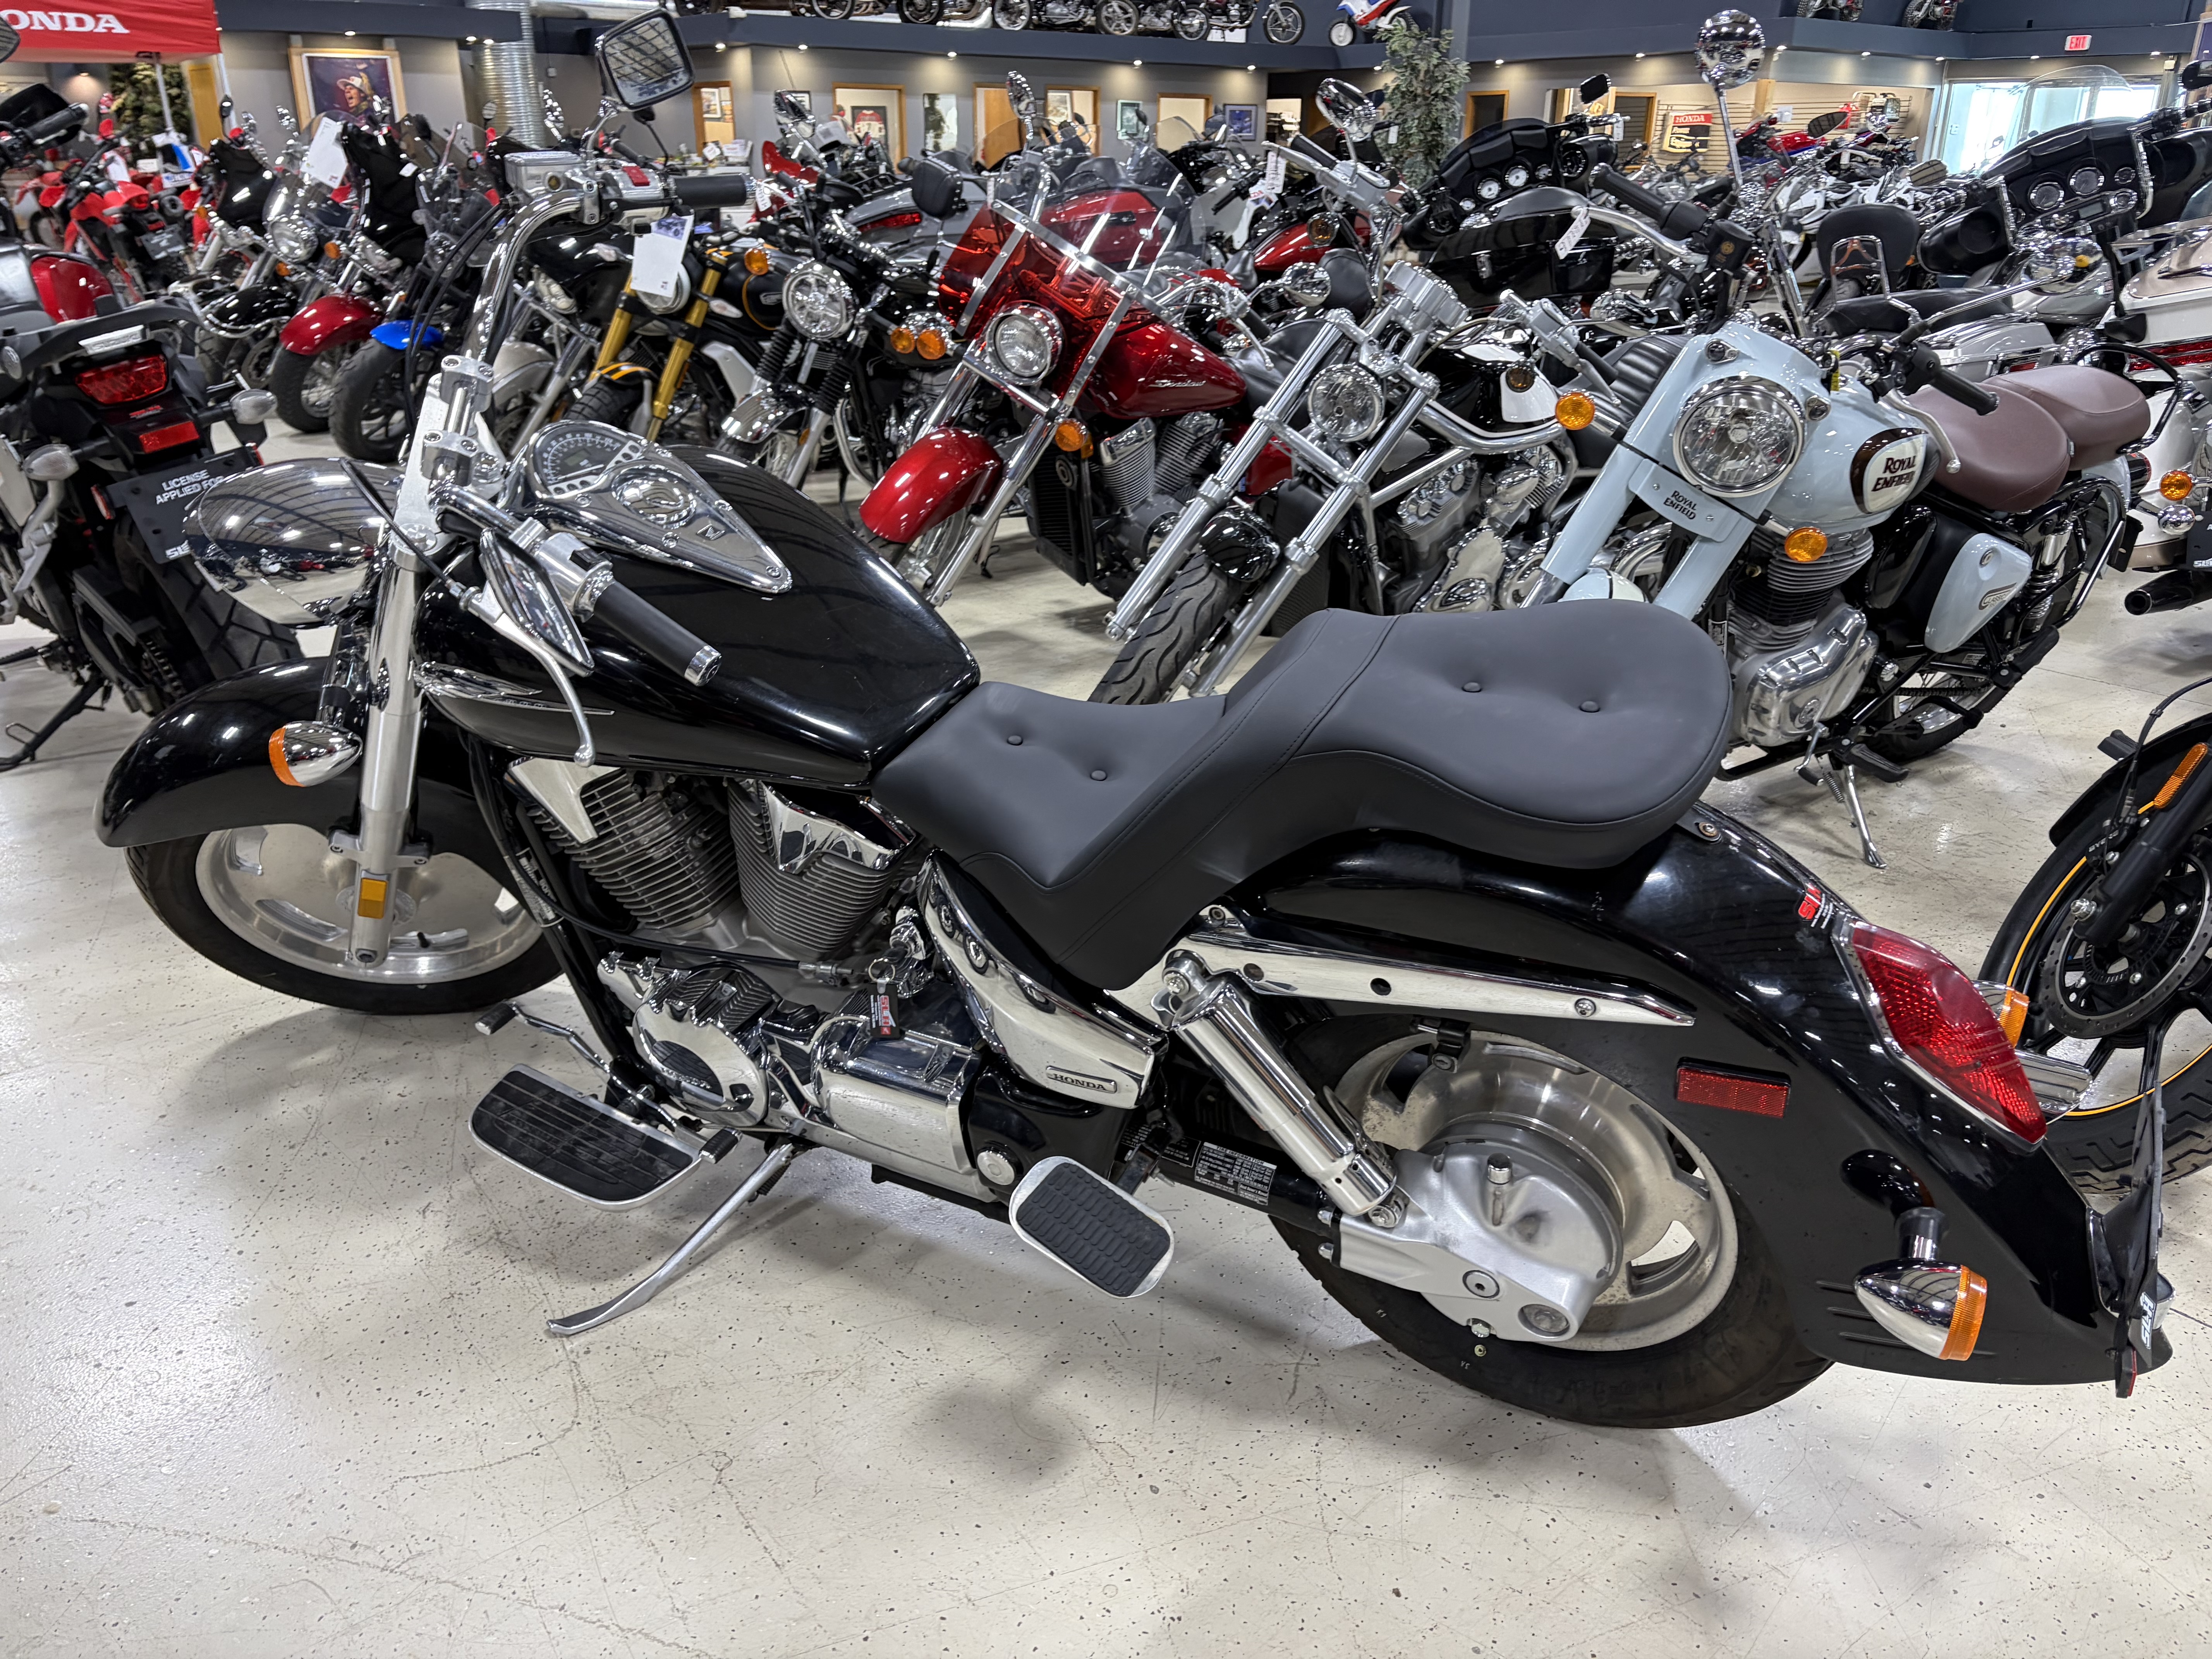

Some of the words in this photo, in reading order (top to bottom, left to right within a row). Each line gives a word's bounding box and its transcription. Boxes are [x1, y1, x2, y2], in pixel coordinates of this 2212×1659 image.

[0, 9, 130, 33] ONDA
[1675, 115, 1705, 123] HONDA
[1882, 455, 1916, 474] ROYAL
[162, 469, 210, 491] LICENSE
[1871, 471, 1916, 491] ENFIELD
[156, 483, 201, 504] APPLIED
[1671, 490, 1697, 510] ROYAL
[1663, 497, 1696, 519] ENFIELD
[1053, 1073, 1107, 1091] HONDA
